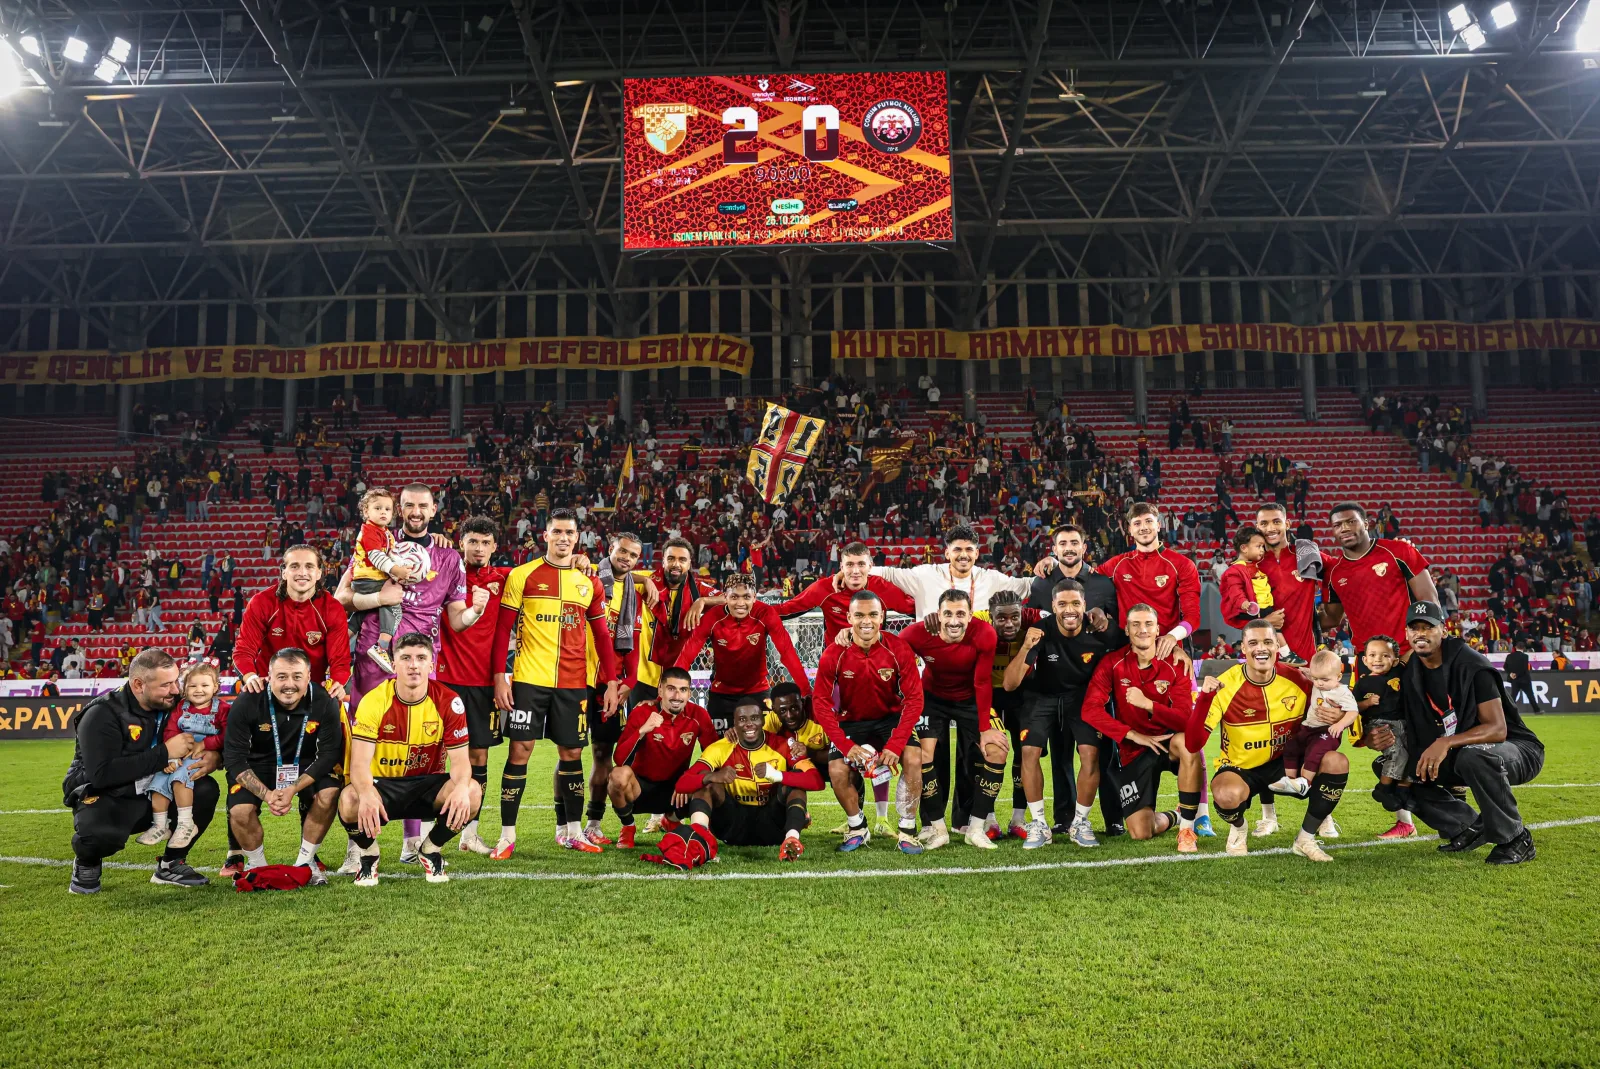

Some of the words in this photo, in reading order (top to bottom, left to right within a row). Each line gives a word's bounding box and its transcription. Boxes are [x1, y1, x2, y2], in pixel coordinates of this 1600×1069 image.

[722, 106, 759, 165] 2
[802, 104, 840, 163] 0
[836, 329, 957, 359] KUTSAL
[968, 327, 1101, 360] ARMAYA
[1111, 326, 1190, 356] OLAN
[185, 348, 224, 373] VE
[232, 348, 307, 373] SPOR
[1564, 680, 1600, 704] TA
